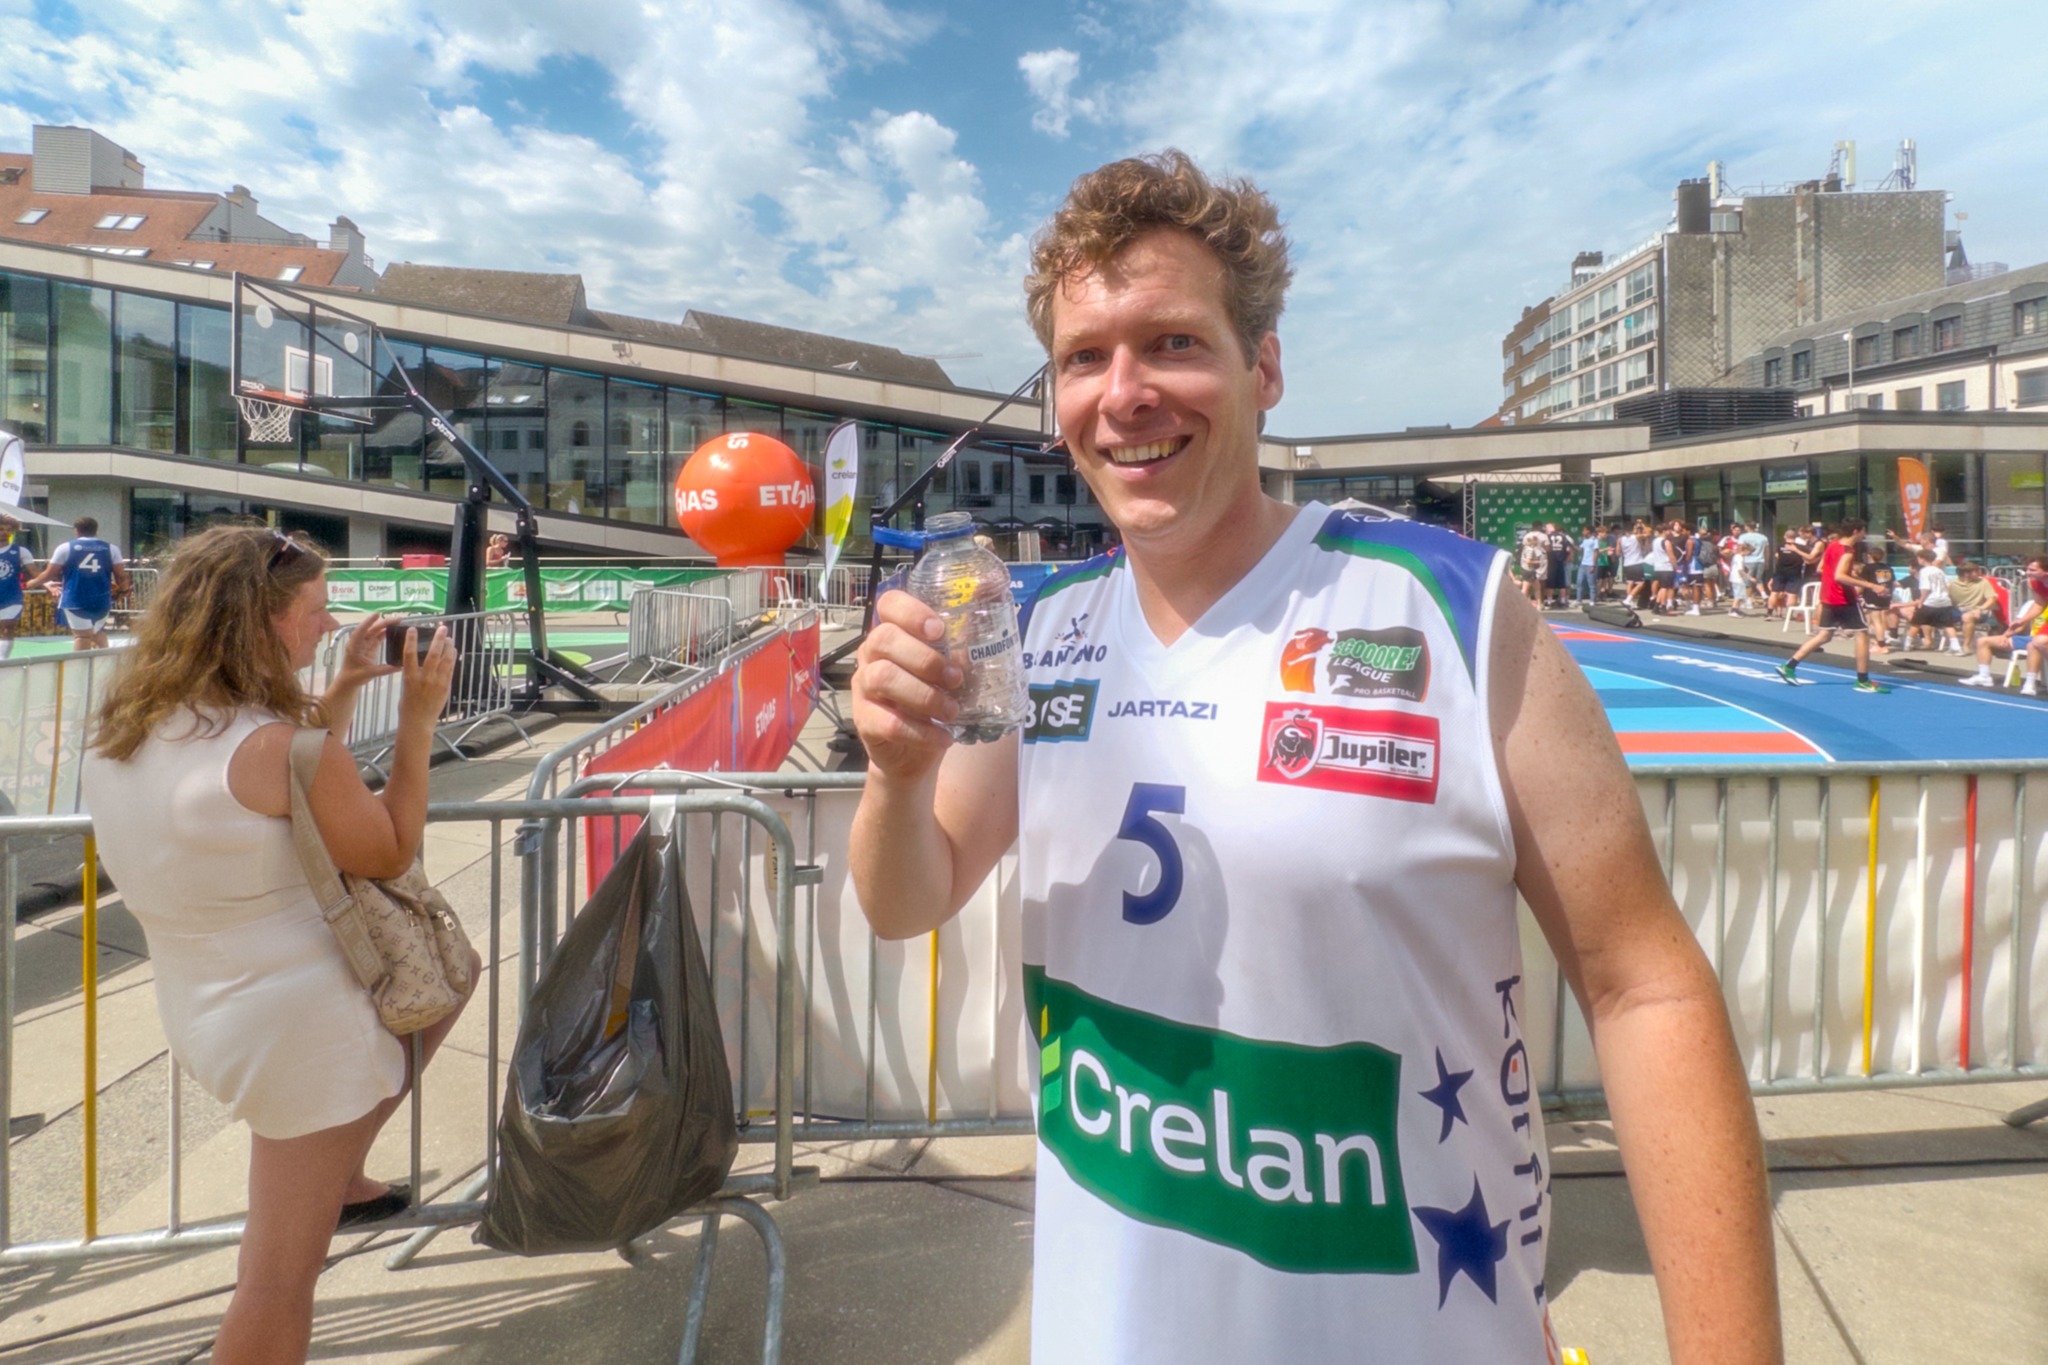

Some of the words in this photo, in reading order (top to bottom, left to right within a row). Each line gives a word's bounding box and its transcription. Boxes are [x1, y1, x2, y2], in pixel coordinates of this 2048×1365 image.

[79, 553, 101, 573] 4
[404, 586, 430, 596] Sprite
[1332, 657, 1394, 684] LEAGUE
[1354, 687, 1372, 696] PRO
[1373, 686, 1417, 699] BASKETBALL
[1024, 693, 1085, 729] BSE
[1107, 699, 1218, 720] JARTAZI
[1116, 781, 1187, 926] 5
[1068, 1048, 1388, 1207] Crelan
